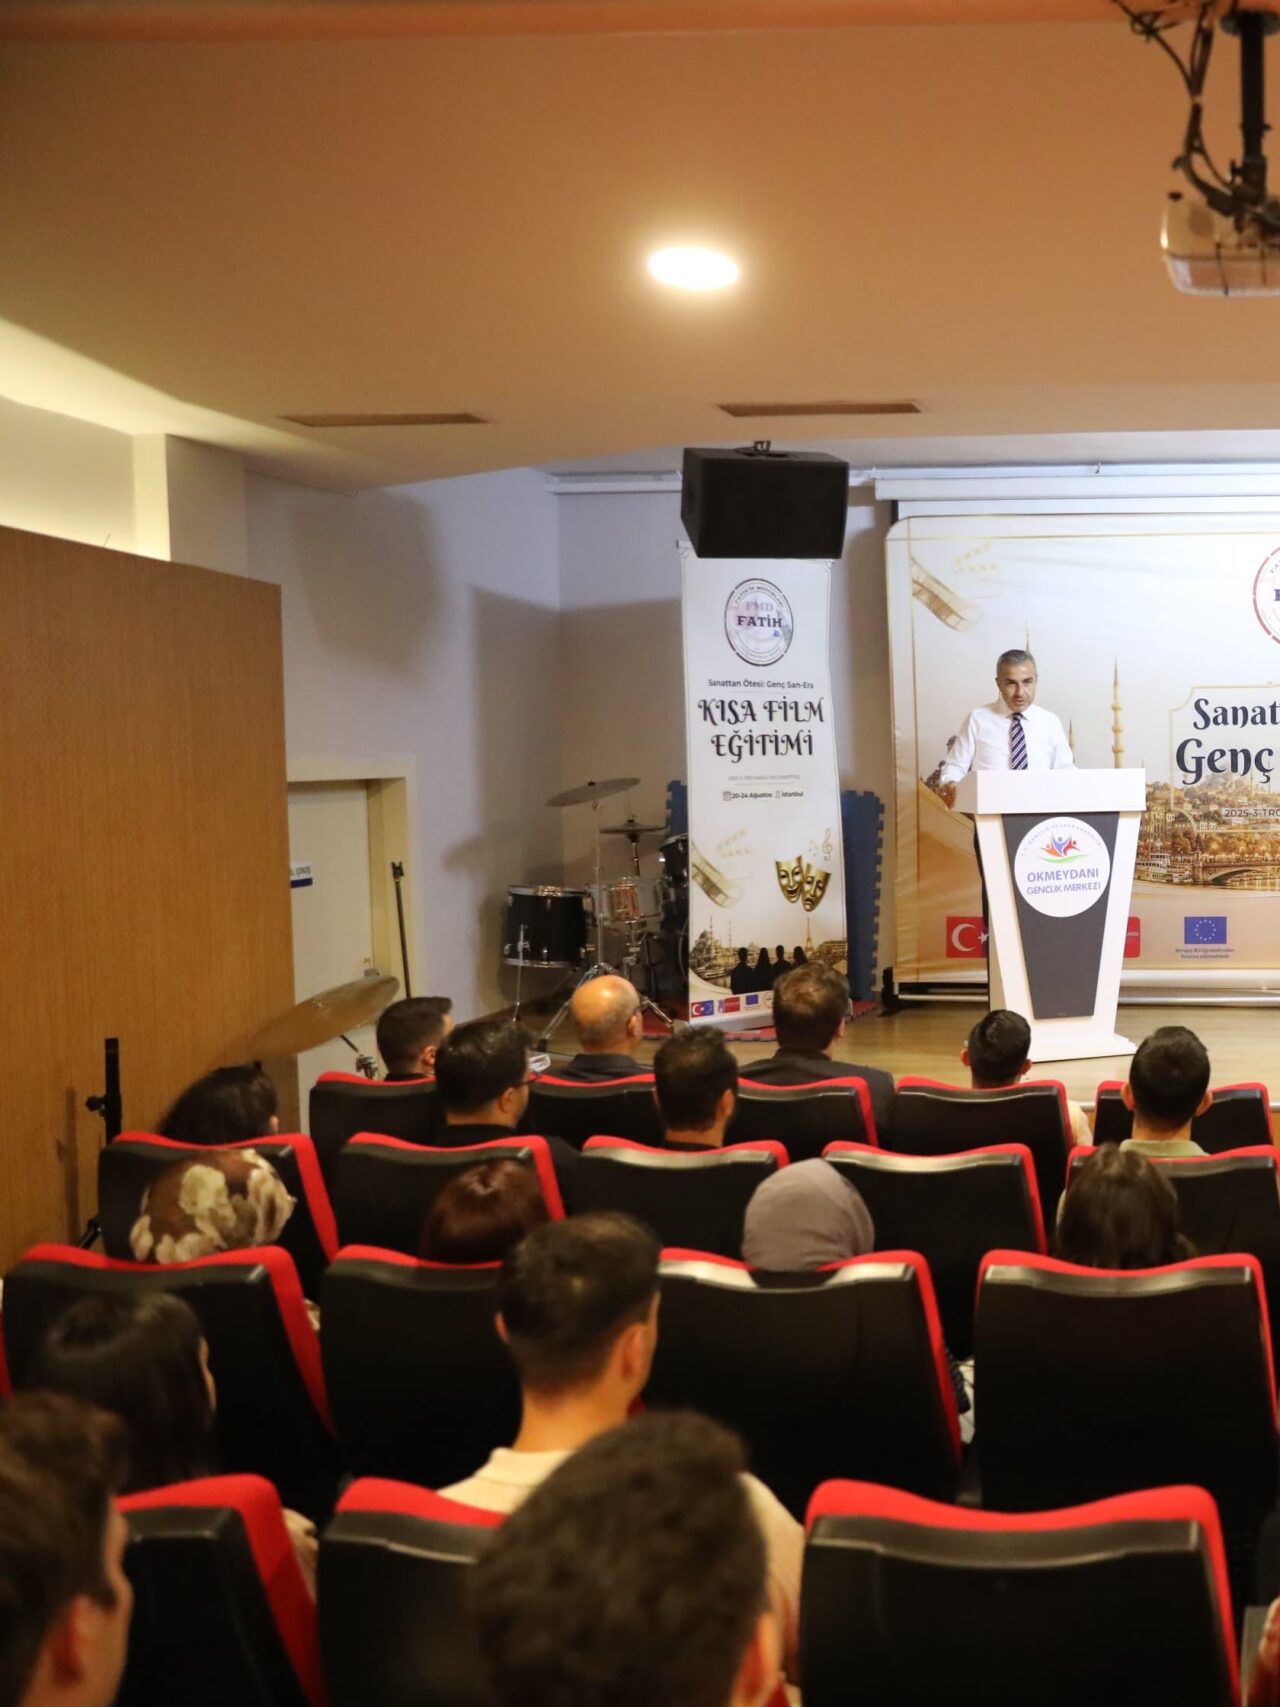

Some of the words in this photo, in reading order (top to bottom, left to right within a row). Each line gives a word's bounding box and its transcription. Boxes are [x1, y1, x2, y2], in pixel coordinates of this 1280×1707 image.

[736, 615, 783, 628] FATİH
[708, 679, 741, 688] Sanattan
[766, 680, 785, 690] Genç
[698, 699, 757, 726] KISA
[763, 696, 824, 722] FİLM
[711, 729, 813, 763] EĞİTİMİ
[1175, 738, 1274, 785] Genç
[1027, 868, 1099, 882] OKMEYDANI
